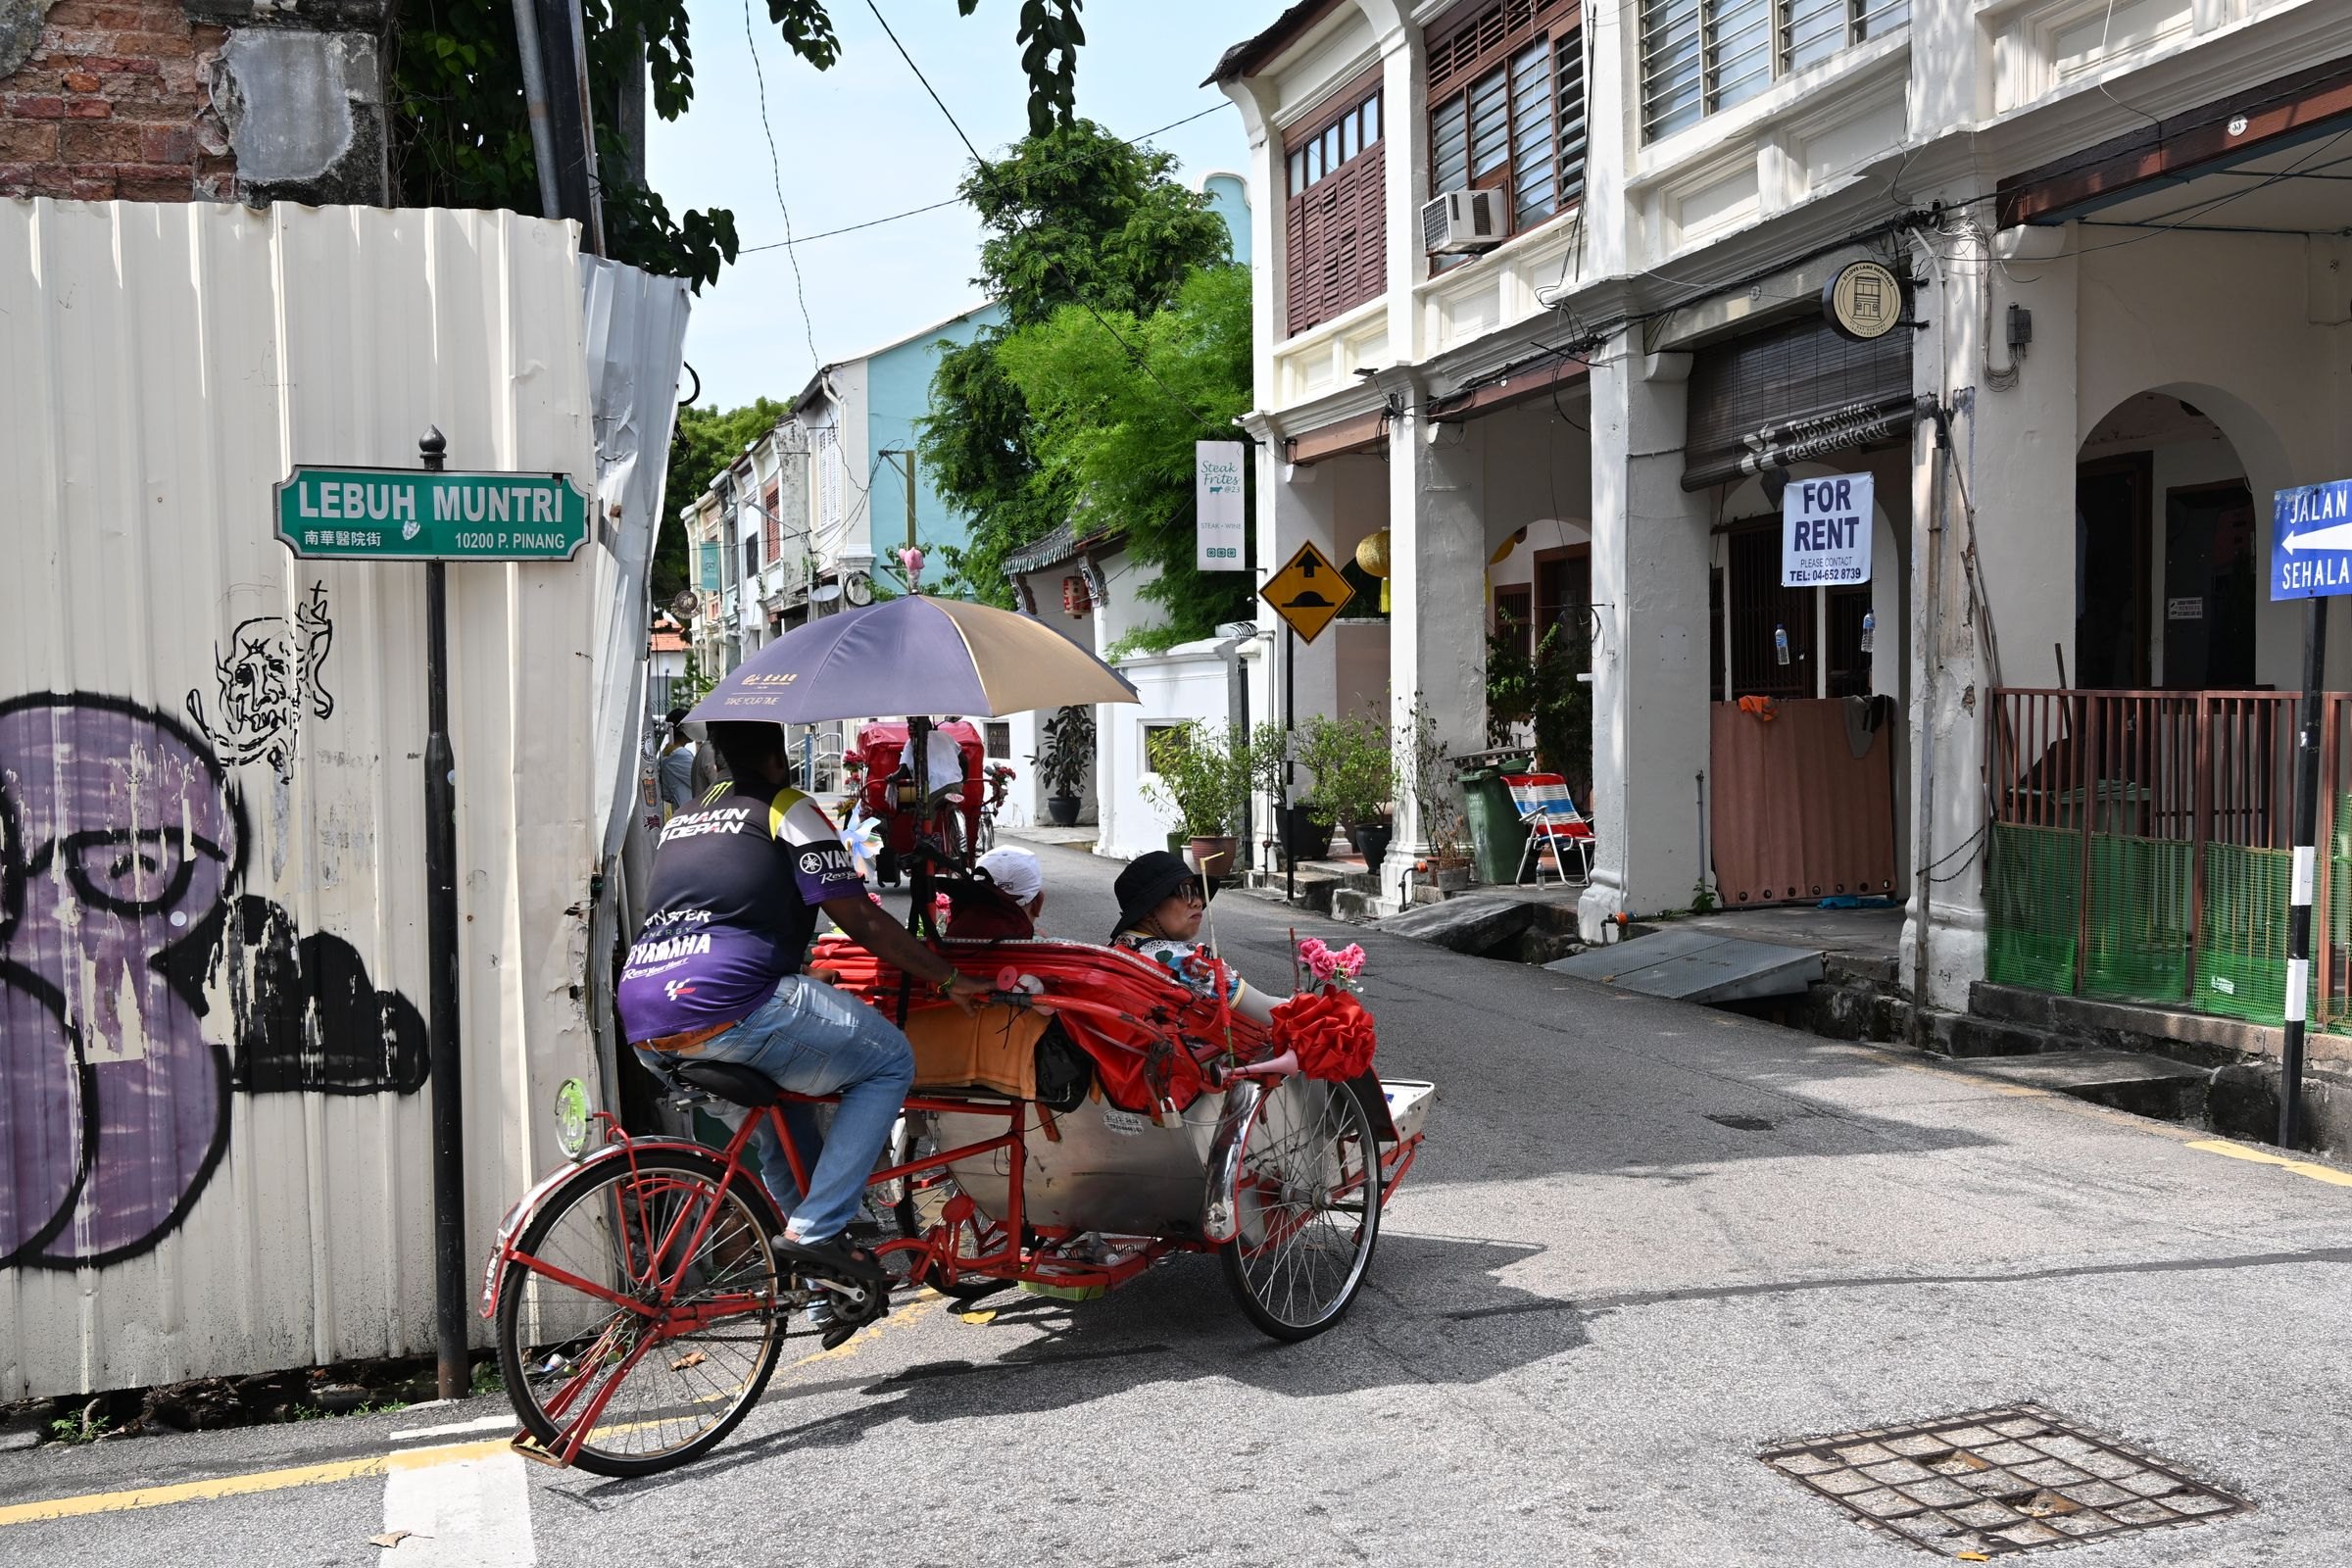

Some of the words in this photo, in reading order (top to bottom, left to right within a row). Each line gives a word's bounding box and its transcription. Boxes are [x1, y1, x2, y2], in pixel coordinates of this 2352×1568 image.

[1847, 267, 1859, 275] LOVE
[1874, 267, 1894, 288] HERITAGE
[1201, 460, 1238, 473] Steak
[1204, 473, 1240, 485] Frites
[1224, 485, 1241, 494] @23
[1803, 479, 1852, 514] FOR
[299, 481, 416, 520] LEBUH
[433, 485, 563, 523] MUNTRI
[2290, 489, 2347, 524] JALAN
[304, 529, 381, 548] 南華醫院街
[455, 532, 494, 550] 10200
[497, 534, 509, 549] P.
[513, 533, 565, 550] PINANG
[1794, 516, 1860, 552] RENT
[1800, 559, 1824, 568] PLEASE
[1825, 557, 1853, 566] CONTACT
[1789, 570, 1811, 582] TEL:
[1812, 568, 1839, 581] 04-652
[1840, 567, 1862, 580] 8739
[2282, 557, 2350, 590] SEHALA
[666, 821, 745, 841] DEPAN
[644, 908, 712, 929] ONSTER
[642, 927, 692, 939] ENERGY
[635, 934, 711, 964] YAMAHA
